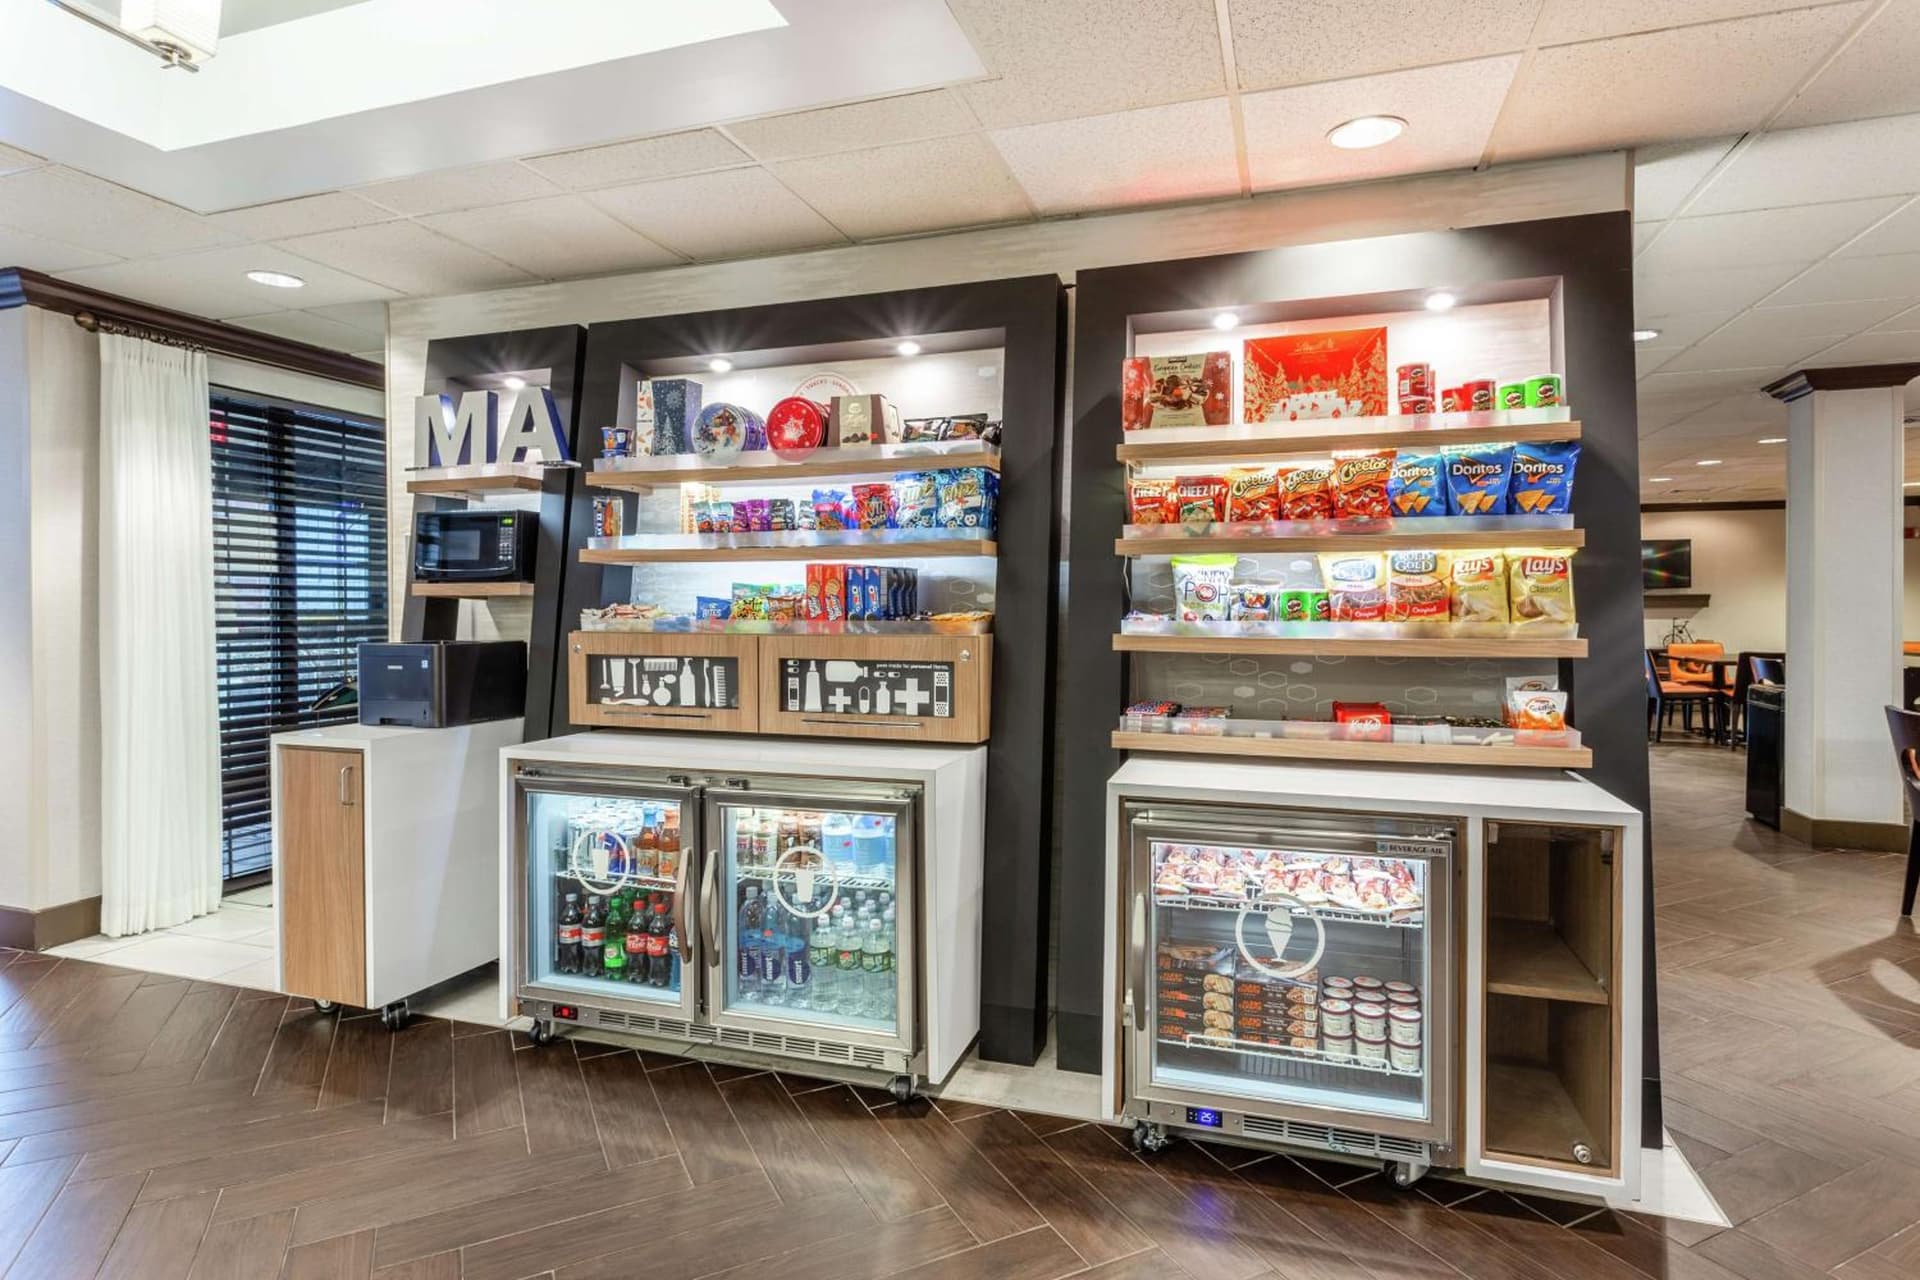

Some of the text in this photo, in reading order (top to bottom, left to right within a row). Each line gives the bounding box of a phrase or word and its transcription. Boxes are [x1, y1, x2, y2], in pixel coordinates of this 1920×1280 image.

[414, 386, 570, 468] MA
[1452, 463, 1503, 476] Doritos
[1513, 462, 1564, 475] Doritos
